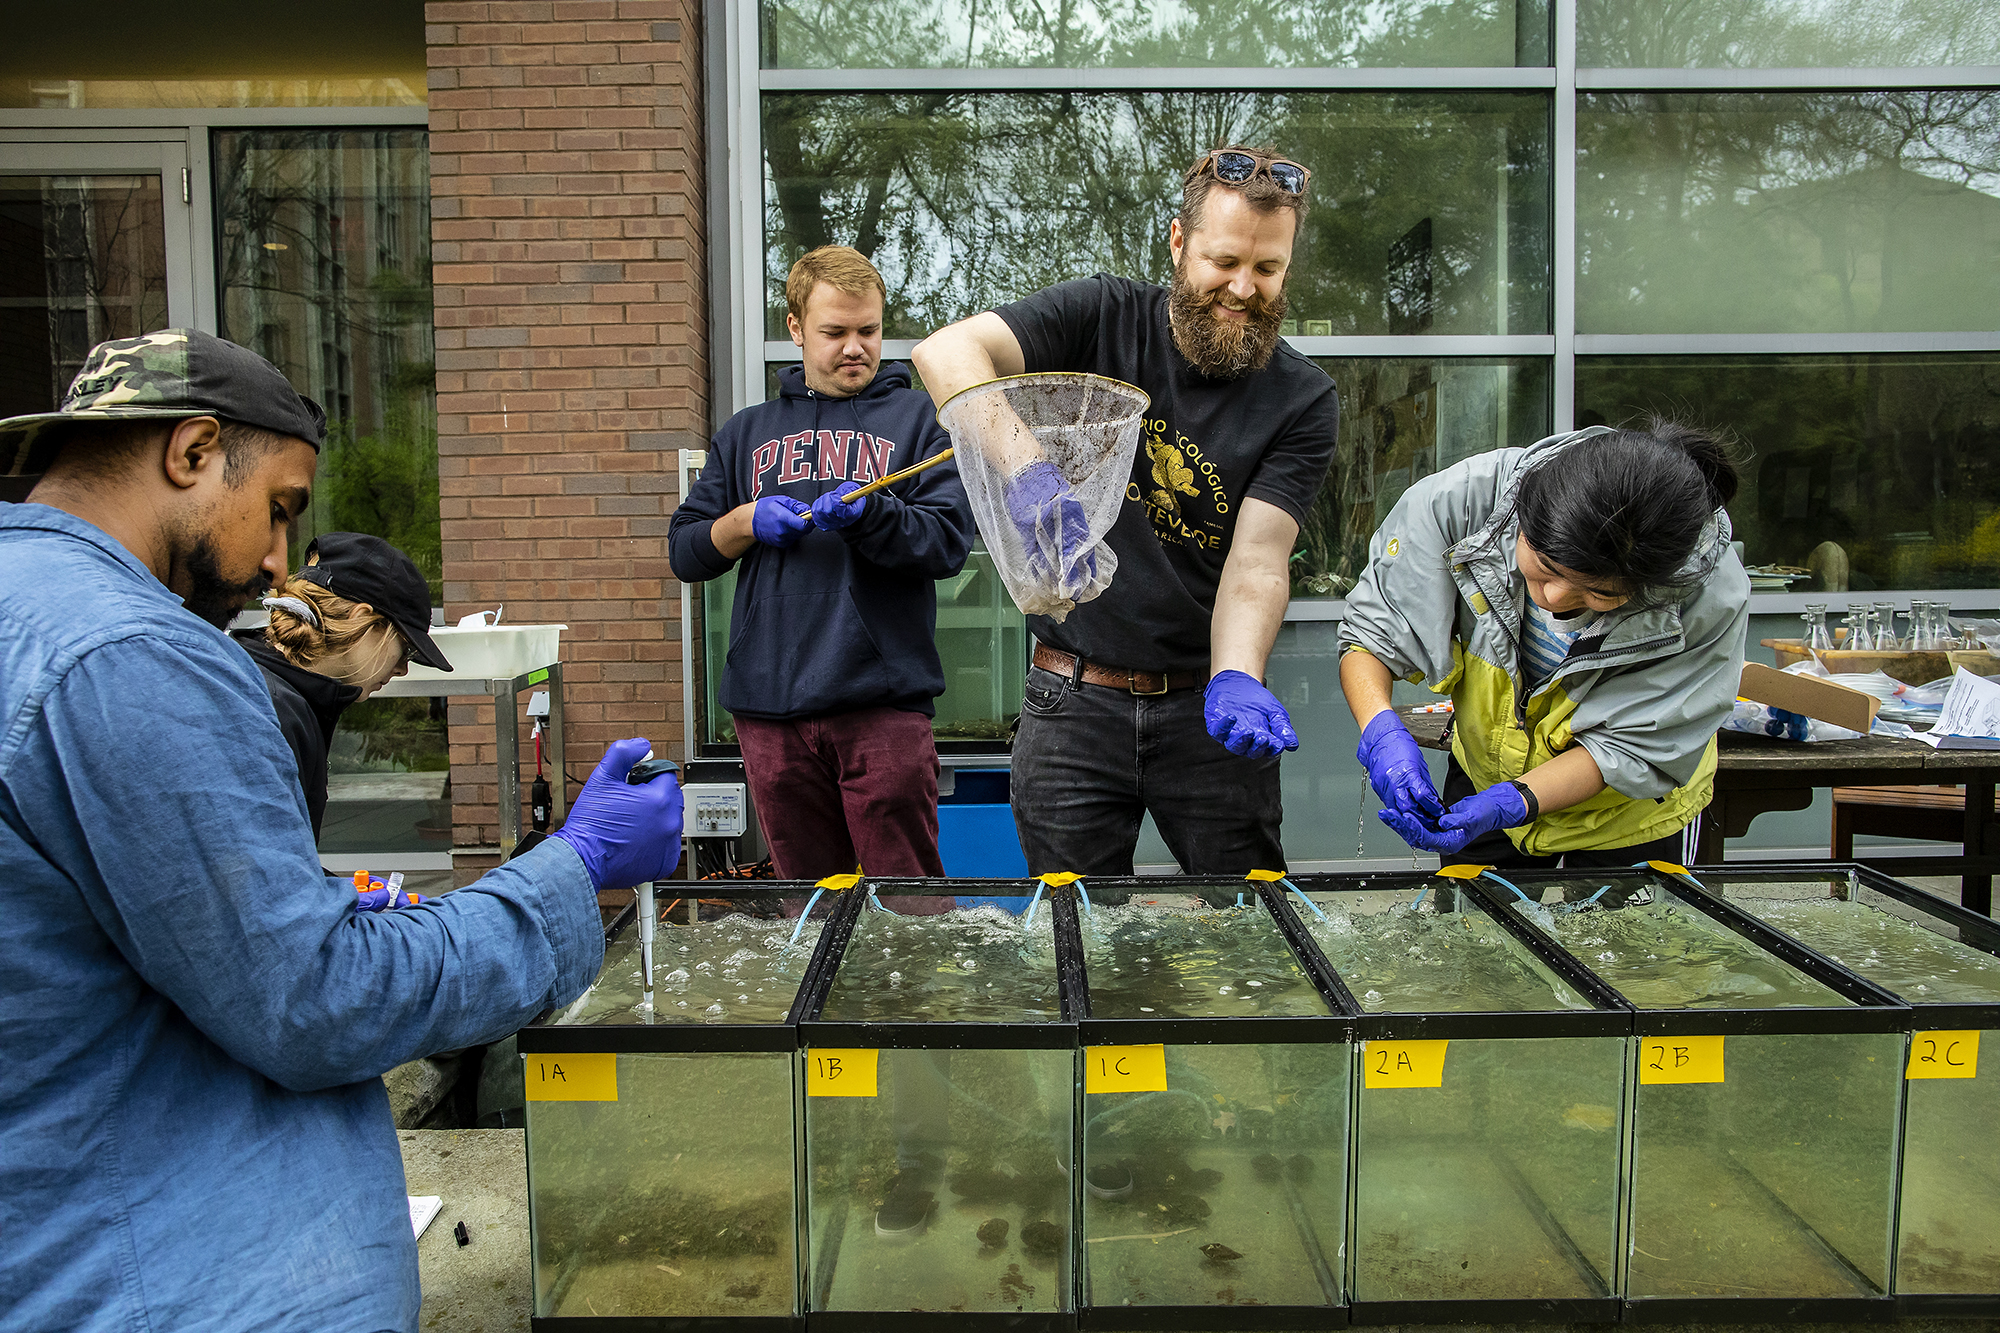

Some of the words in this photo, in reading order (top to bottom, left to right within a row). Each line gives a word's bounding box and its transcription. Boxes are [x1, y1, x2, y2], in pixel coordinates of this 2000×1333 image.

[751, 429, 896, 501] PENN
[1376, 1050, 1413, 1075] 2A
[1649, 1045, 1691, 1071] 2B
[1920, 1040, 1966, 1067] 2C
[540, 1062, 567, 1083] 1A
[817, 1057, 844, 1081] 1B
[1101, 1057, 1131, 1077] 1C
